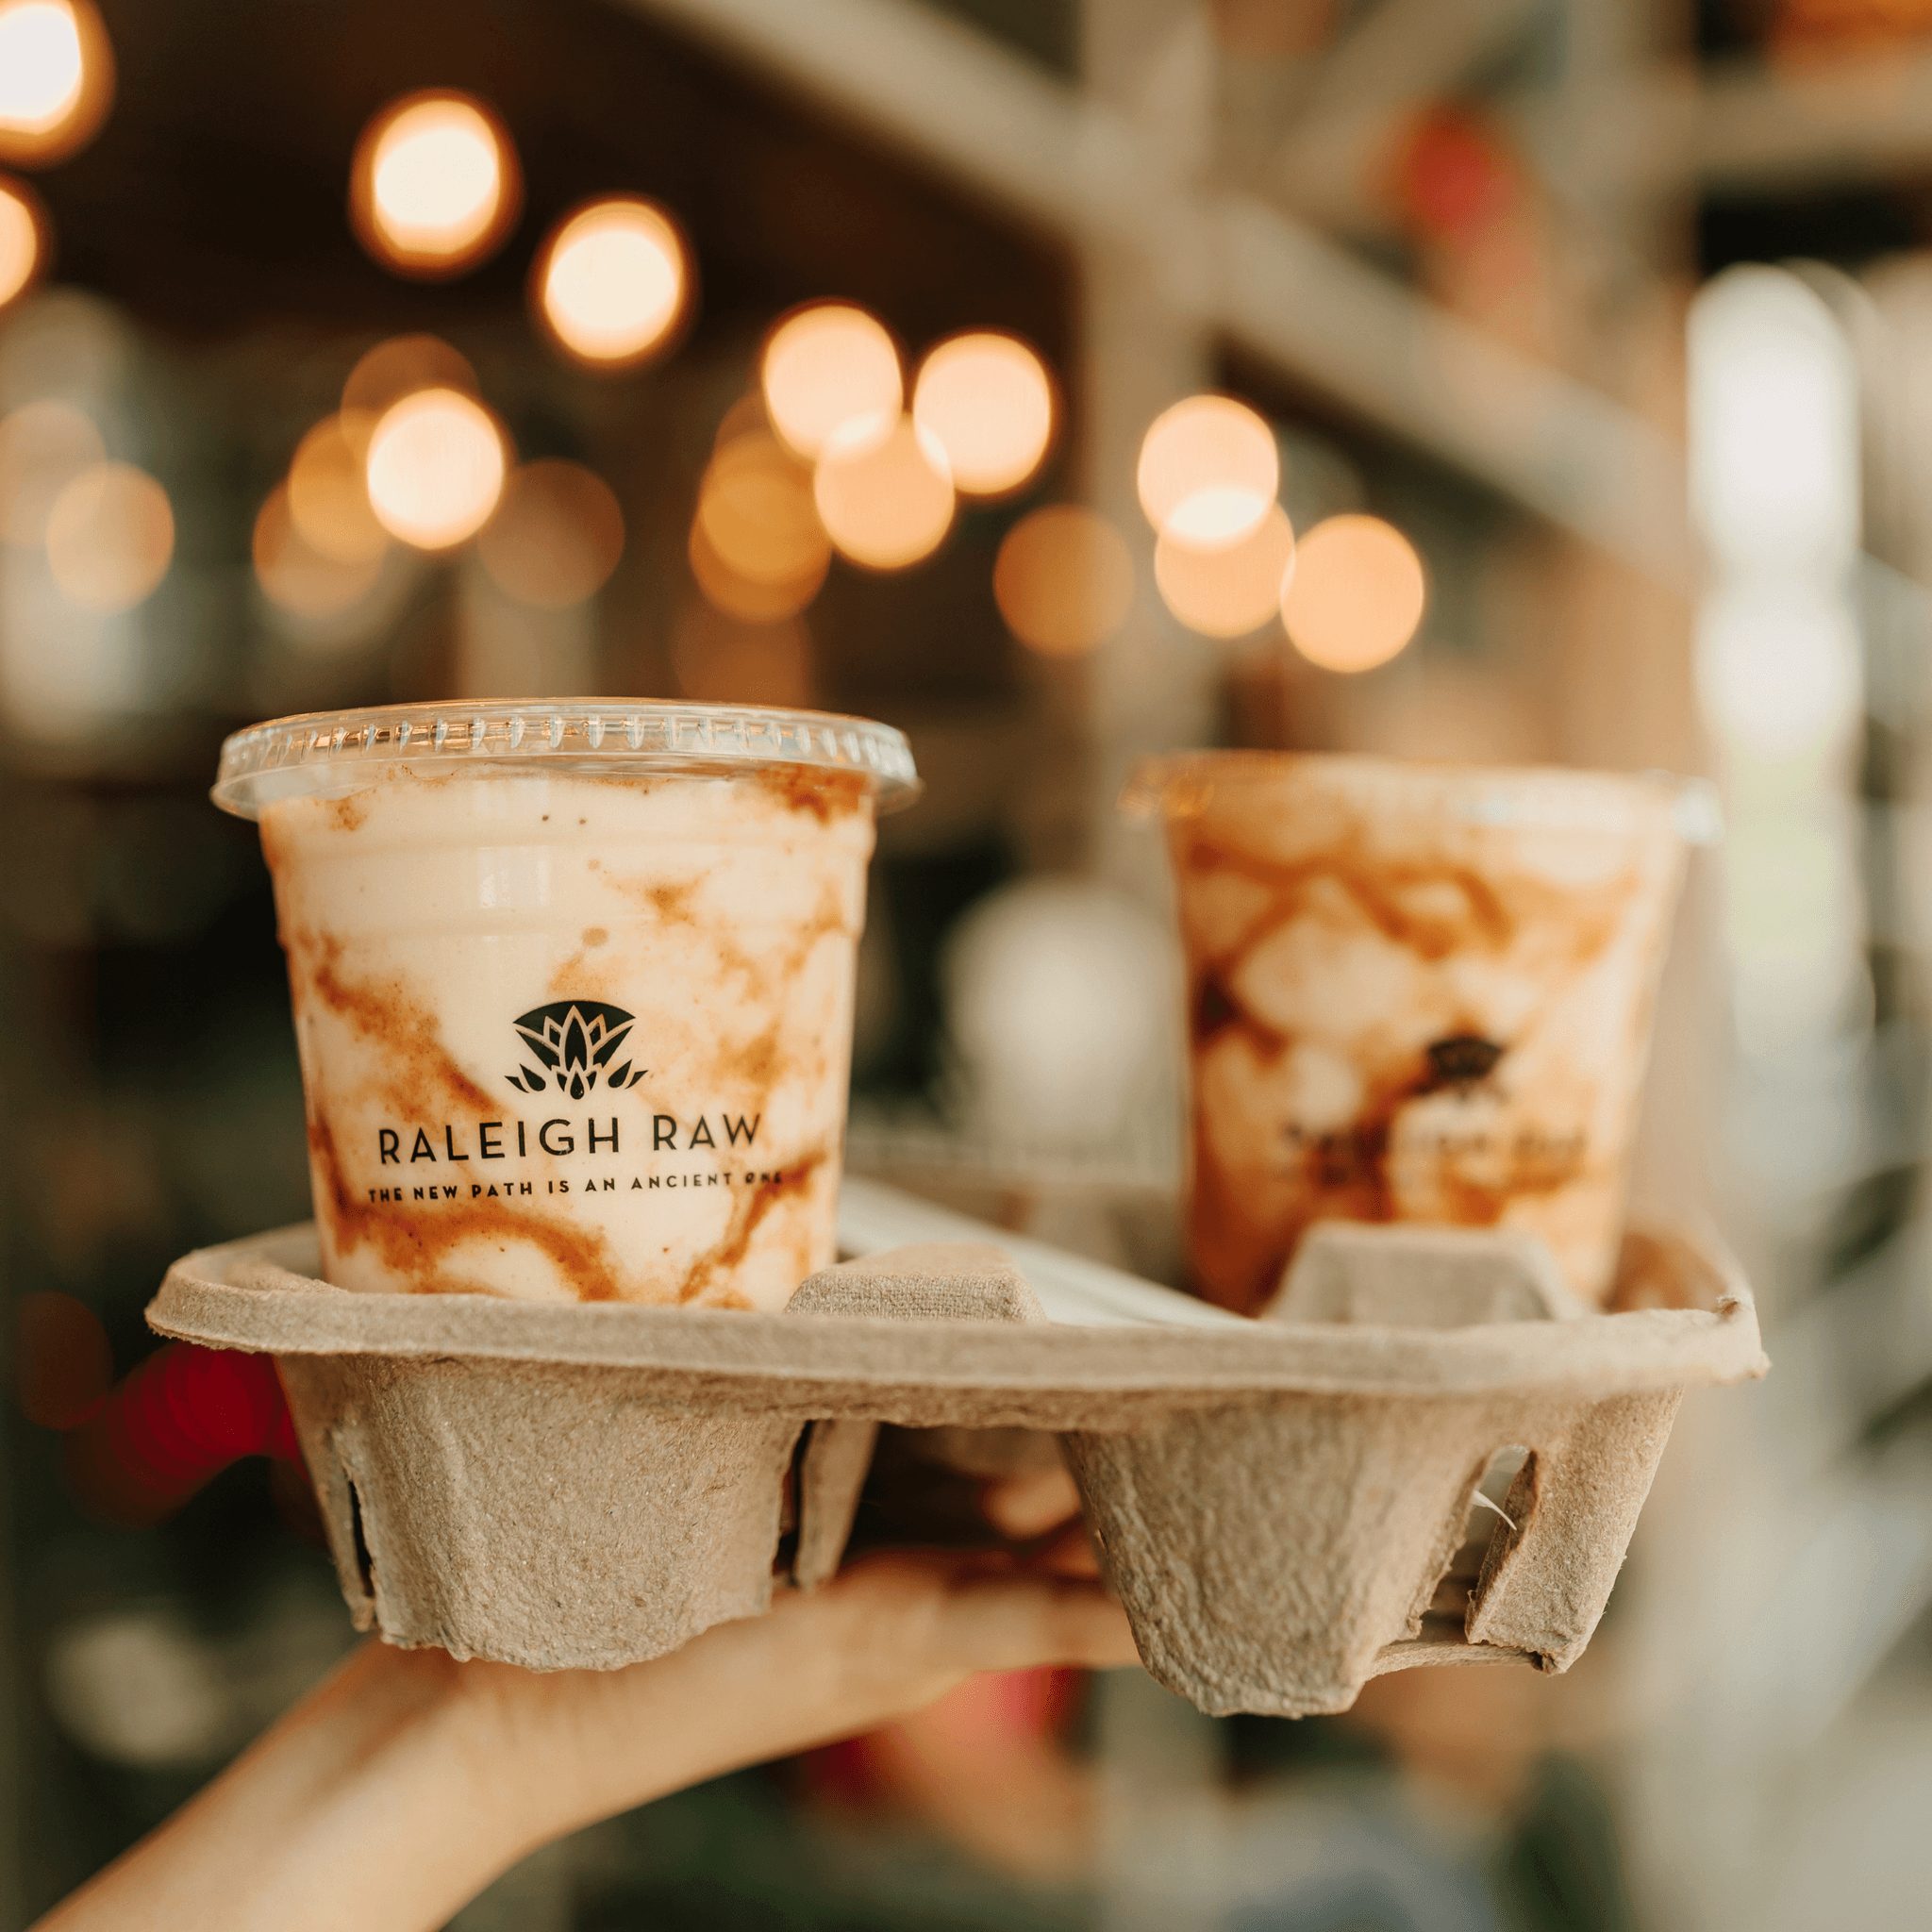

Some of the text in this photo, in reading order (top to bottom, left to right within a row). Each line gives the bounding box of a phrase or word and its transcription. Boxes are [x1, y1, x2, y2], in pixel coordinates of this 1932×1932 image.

[378, 1113, 761, 1165] RALEIGH RAW
[368, 1187, 403, 1204] THE
[413, 1185, 458, 1201] NEW
[472, 1181, 533, 1199] PATH
[548, 1179, 570, 1194] IS
[585, 1177, 616, 1192] AN
[630, 1172, 732, 1190] ANCIENT
